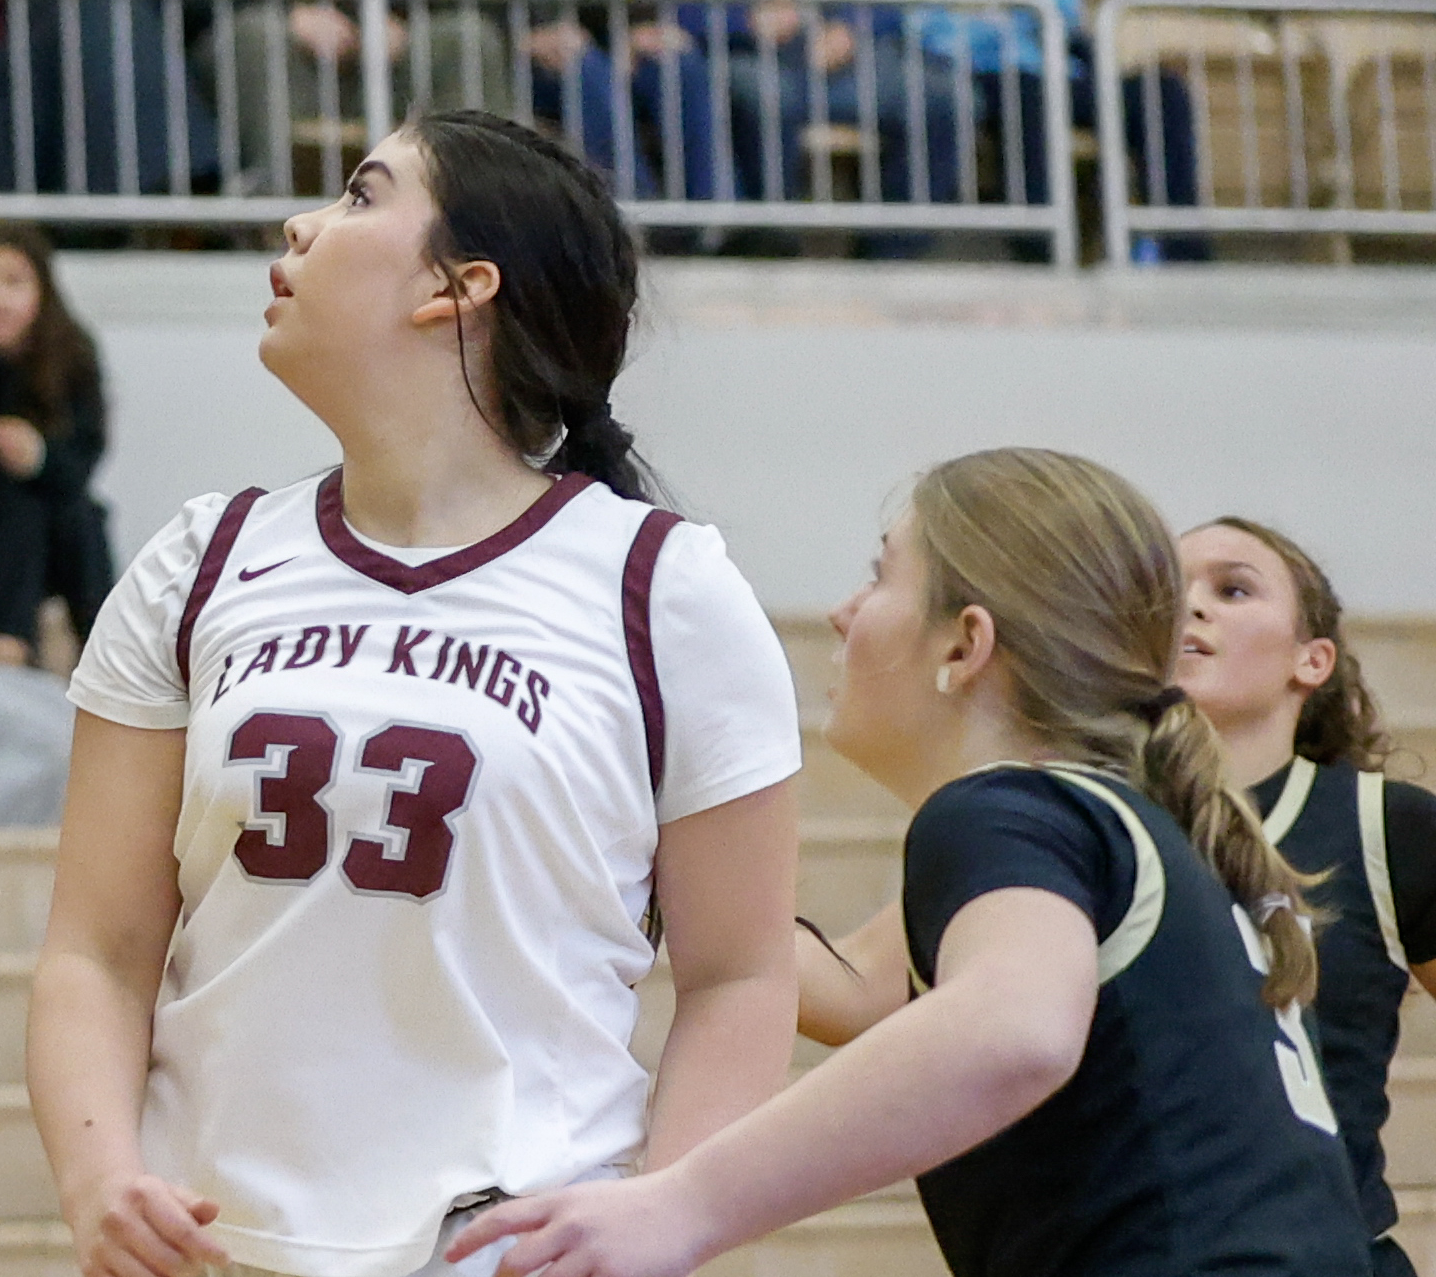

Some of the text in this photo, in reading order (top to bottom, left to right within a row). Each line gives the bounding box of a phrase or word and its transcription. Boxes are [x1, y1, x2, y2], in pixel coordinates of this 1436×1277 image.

[211, 624, 552, 737] LADY KINGS
[222, 706, 485, 906] 33
